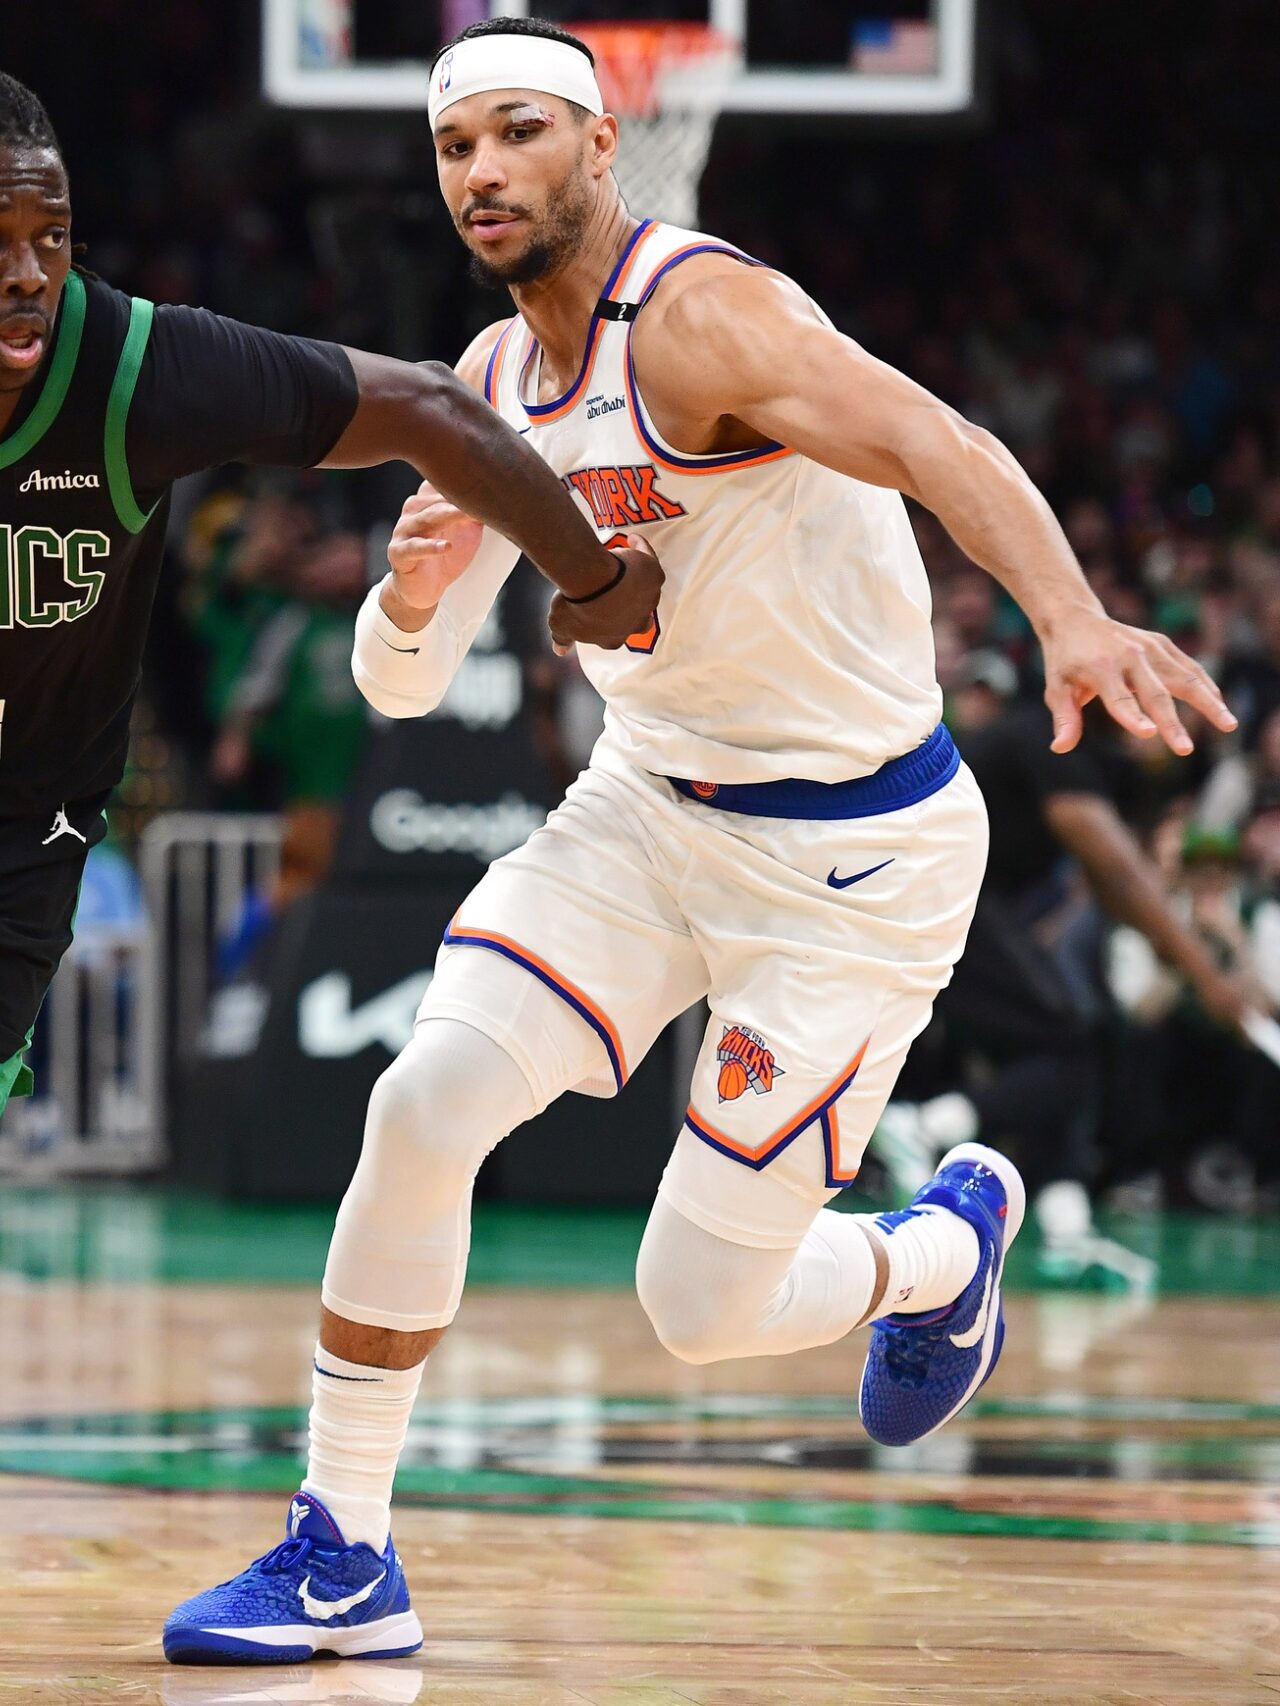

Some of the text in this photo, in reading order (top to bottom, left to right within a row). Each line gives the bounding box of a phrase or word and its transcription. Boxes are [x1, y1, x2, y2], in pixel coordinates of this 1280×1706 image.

[19, 469, 100, 492] Amica
[569, 466, 686, 528] YORK
[717, 1026, 775, 1092] KNICKS
